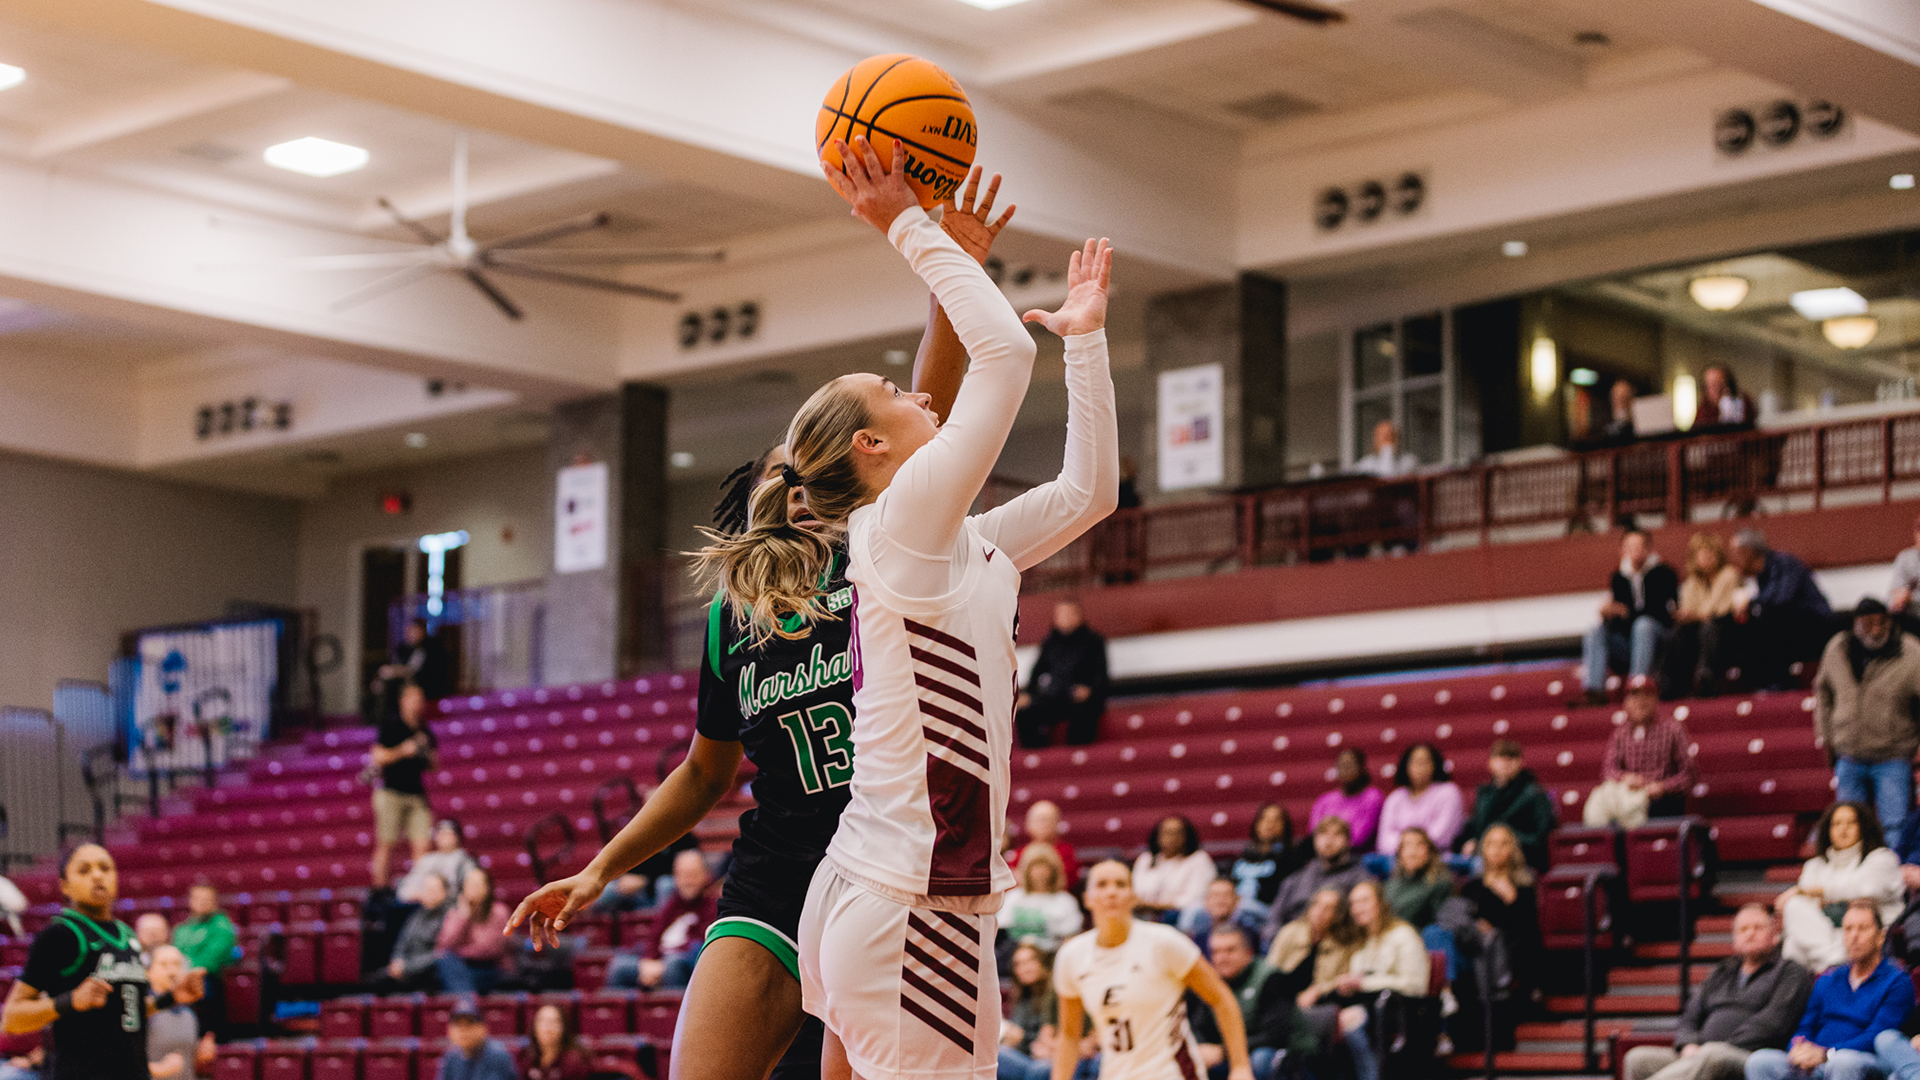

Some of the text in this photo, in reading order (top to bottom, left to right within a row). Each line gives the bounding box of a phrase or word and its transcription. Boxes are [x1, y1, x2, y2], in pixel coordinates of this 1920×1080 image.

[904, 154, 959, 200] ilson
[828, 585, 853, 612] SB
[739, 643, 852, 720] Marsha
[777, 701, 854, 795] 13
[121, 983, 140, 1032] 3
[1108, 1017, 1134, 1052] 31
